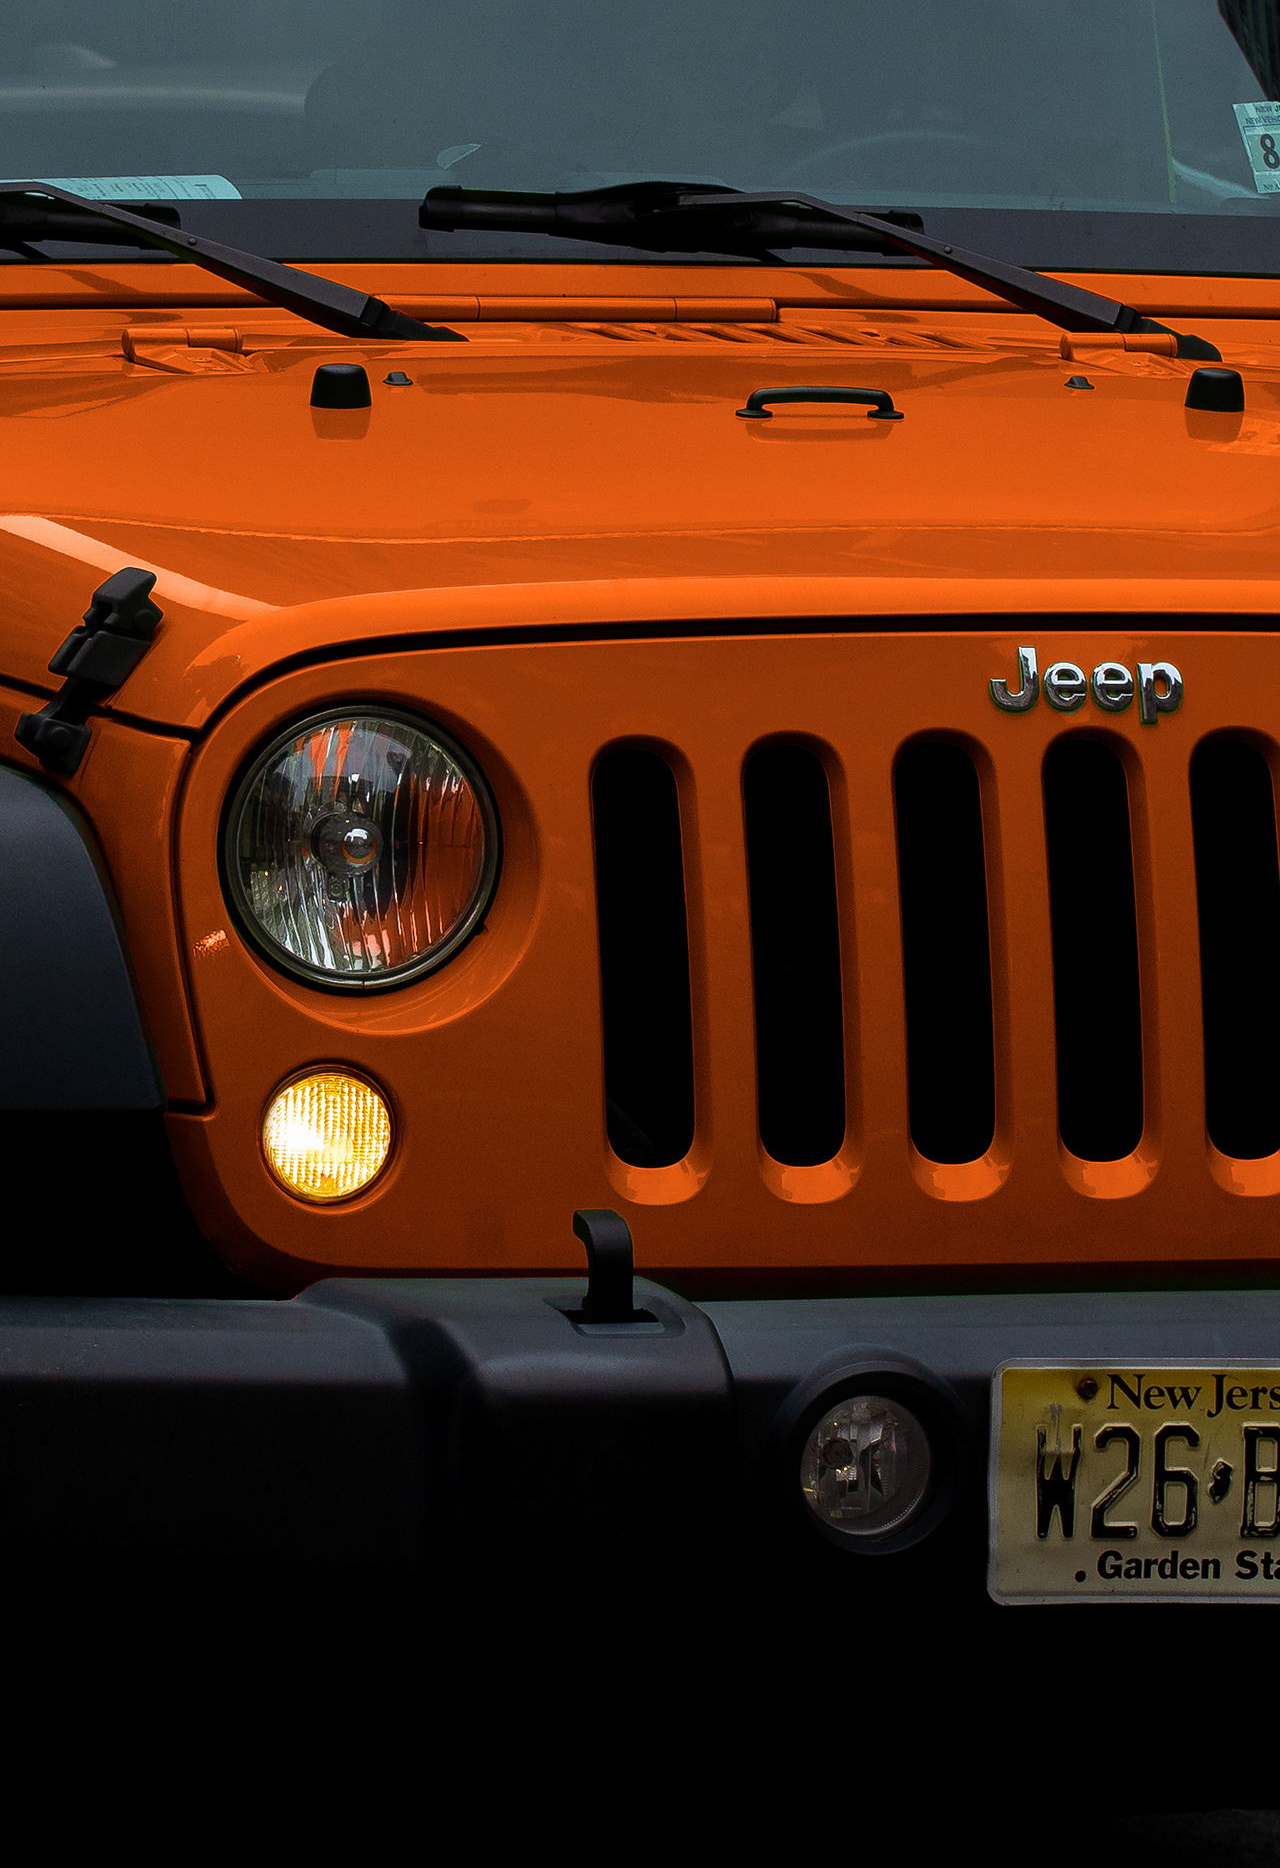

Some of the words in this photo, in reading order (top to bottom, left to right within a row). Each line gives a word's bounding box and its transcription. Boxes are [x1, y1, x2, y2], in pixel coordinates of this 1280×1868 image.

[1255, 105, 1273, 113] NEW
[1260, 133, 1280, 169] 8
[988, 646, 1183, 724] Jeep
[1106, 1373, 1202, 1411] New
[1096, 1550, 1222, 1581] Garden
